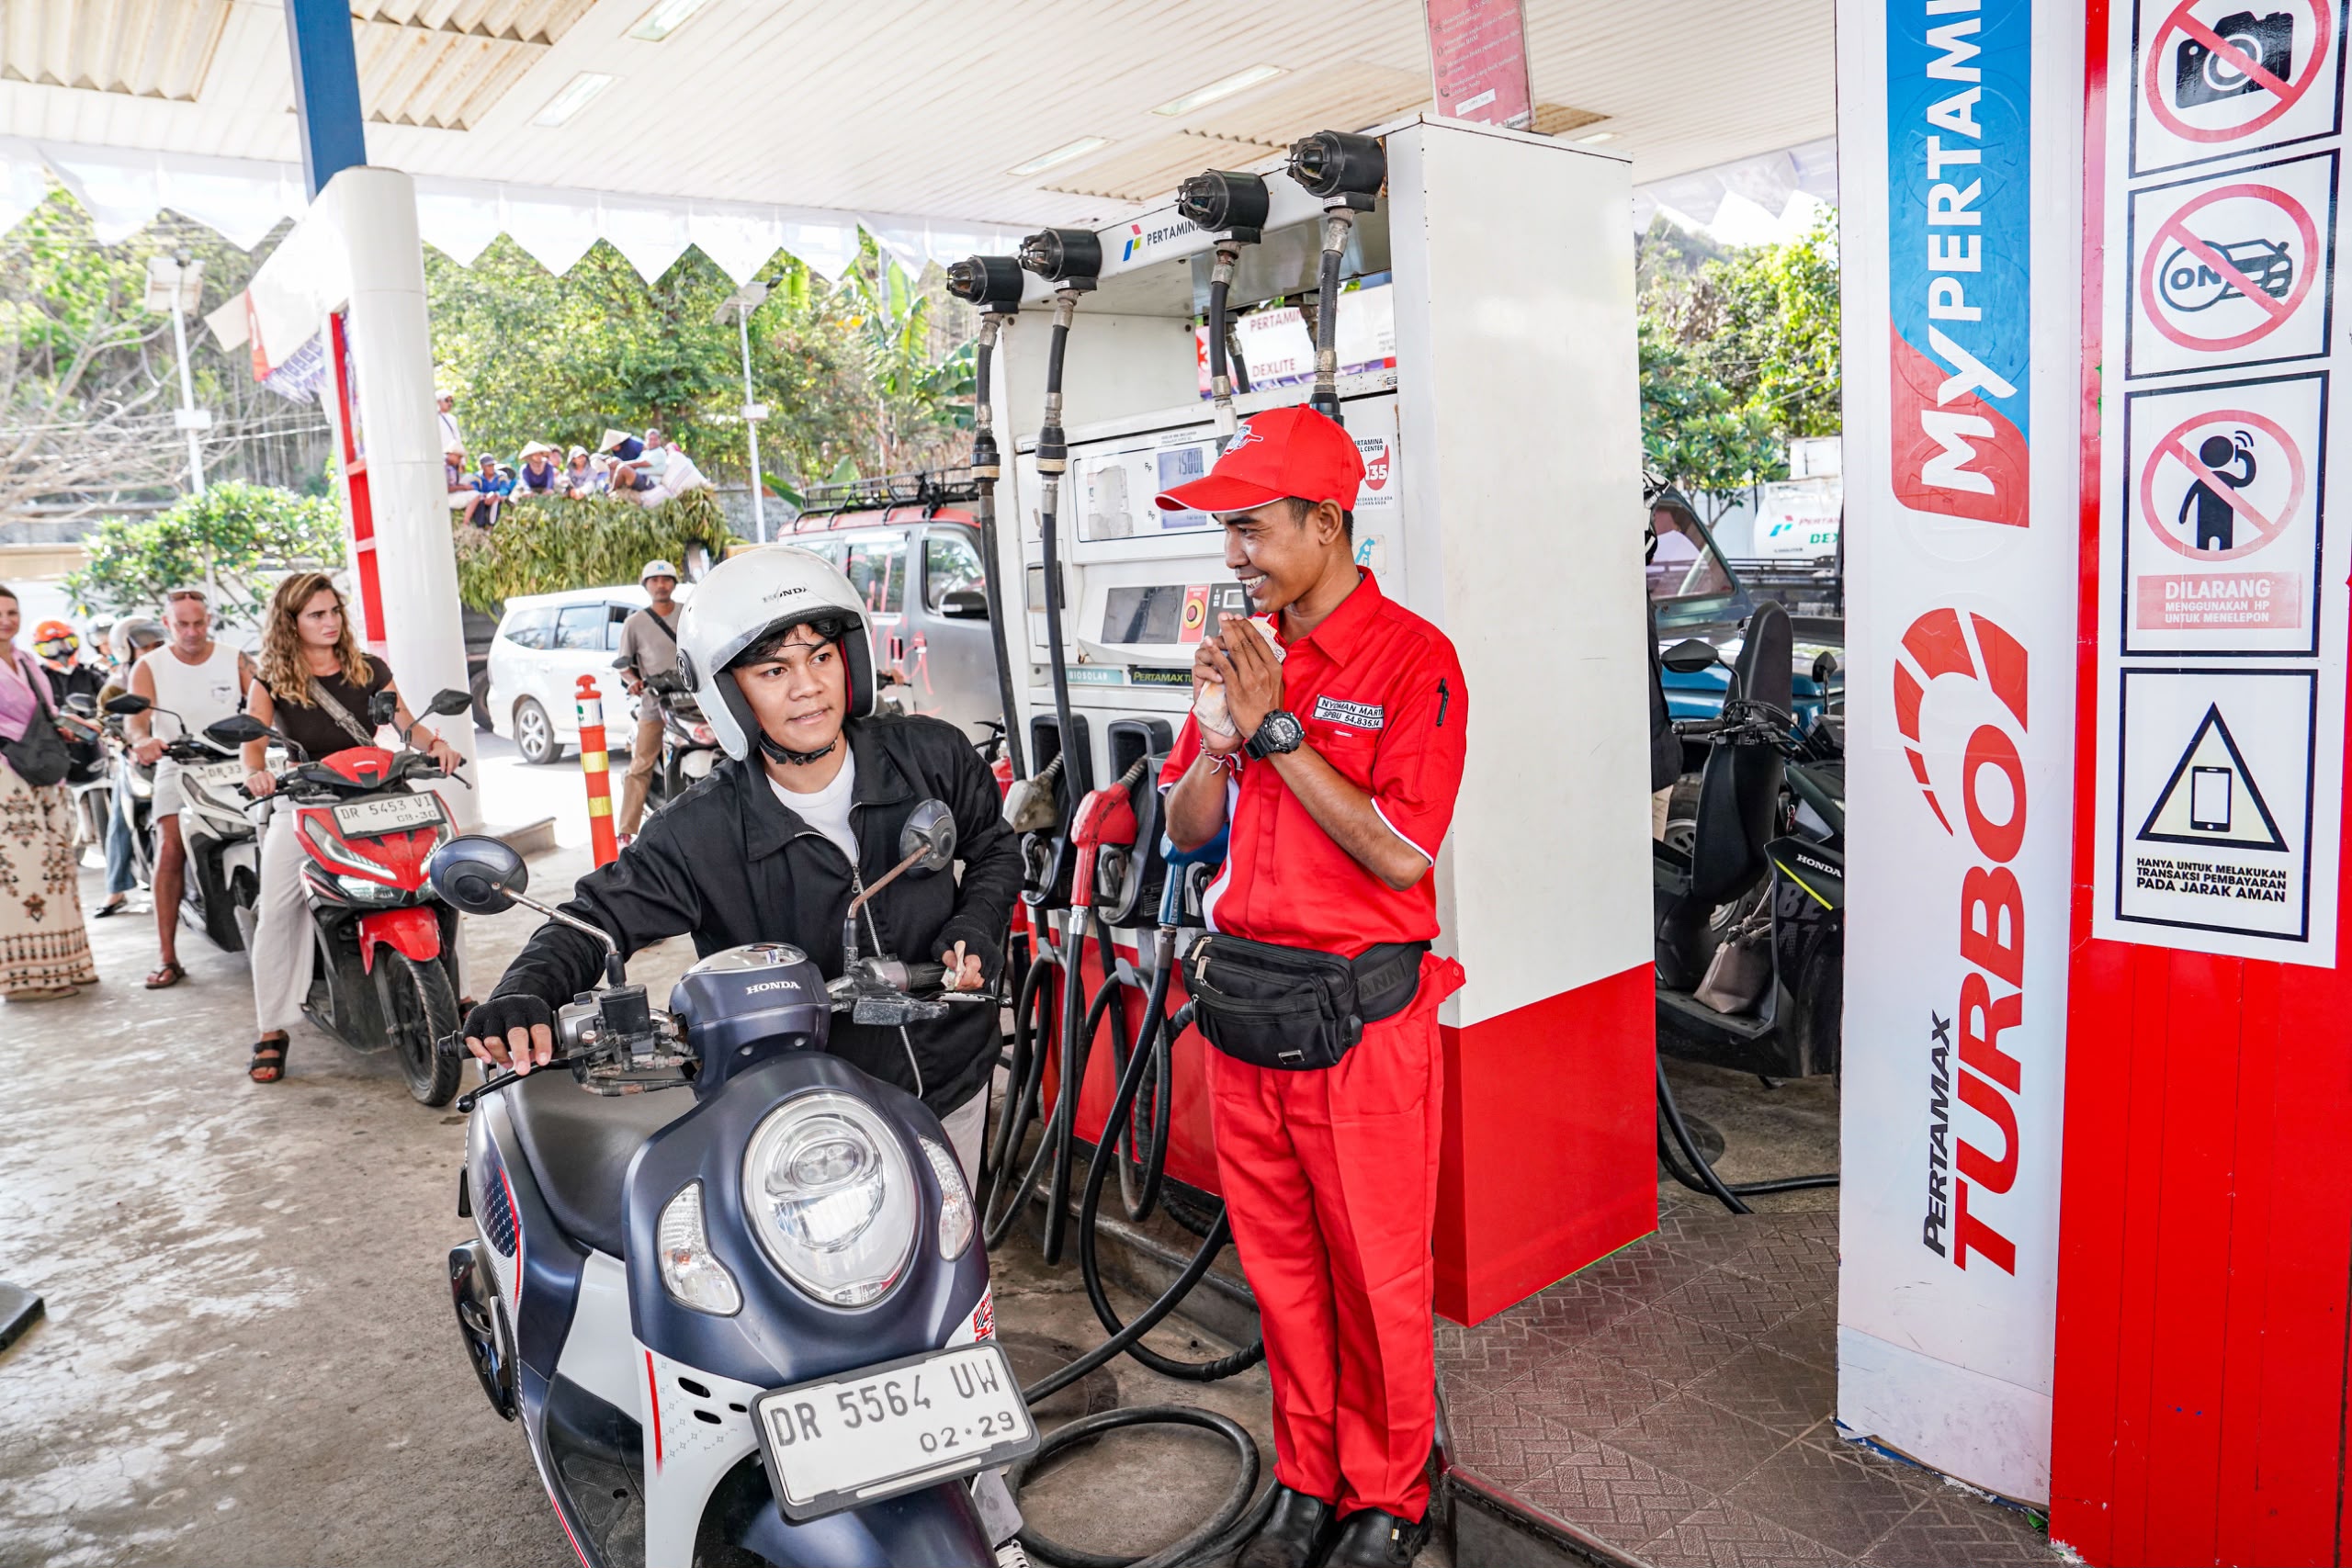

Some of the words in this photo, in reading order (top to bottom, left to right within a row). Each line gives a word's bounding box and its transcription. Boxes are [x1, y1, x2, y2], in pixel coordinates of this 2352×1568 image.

[1147, 220, 1199, 246] PERTAMIN
[2170, 265, 2222, 290] ON
[1251, 357, 1296, 378] DEXLITE
[1354, 438, 1383, 446] ERTAMINA
[1365, 464, 1388, 480] 135
[2165, 579, 2271, 600] DILARANG
[2165, 601, 2248, 612] MENGGUNAKAN
[2254, 600, 2270, 611] HP
[2165, 613, 2200, 623] UNTUK
[2203, 613, 2270, 623] MENELEPON
[1069, 671, 1108, 681] BIOSOLAR
[1133, 671, 1183, 682] PERTAMAX
[1323, 711, 1342, 719] SPBU
[340, 807, 360, 819] DR
[368, 800, 407, 816] 5453
[1796, 853, 1842, 878] HONDA
[2137, 857, 2174, 869] HANYA
[2177, 861, 2212, 873] UNTUK
[2215, 864, 2287, 879] MELAKUKAN
[2137, 867, 2200, 882] TRANSAKSI
[2203, 873, 2287, 890] PEMBAYARAN
[2136, 877, 2176, 892] PADA
[2179, 881, 2232, 897] JARAK
[2235, 887, 2286, 903] AMAN
[745, 980, 801, 996] HONDA
[1953, 724, 2027, 1277] TURBO
[1923, 1010, 1951, 1258] PERTAMAX
[770, 1402, 822, 1447] DR
[835, 1374, 932, 1428] 5564
[949, 1359, 1000, 1399] UW
